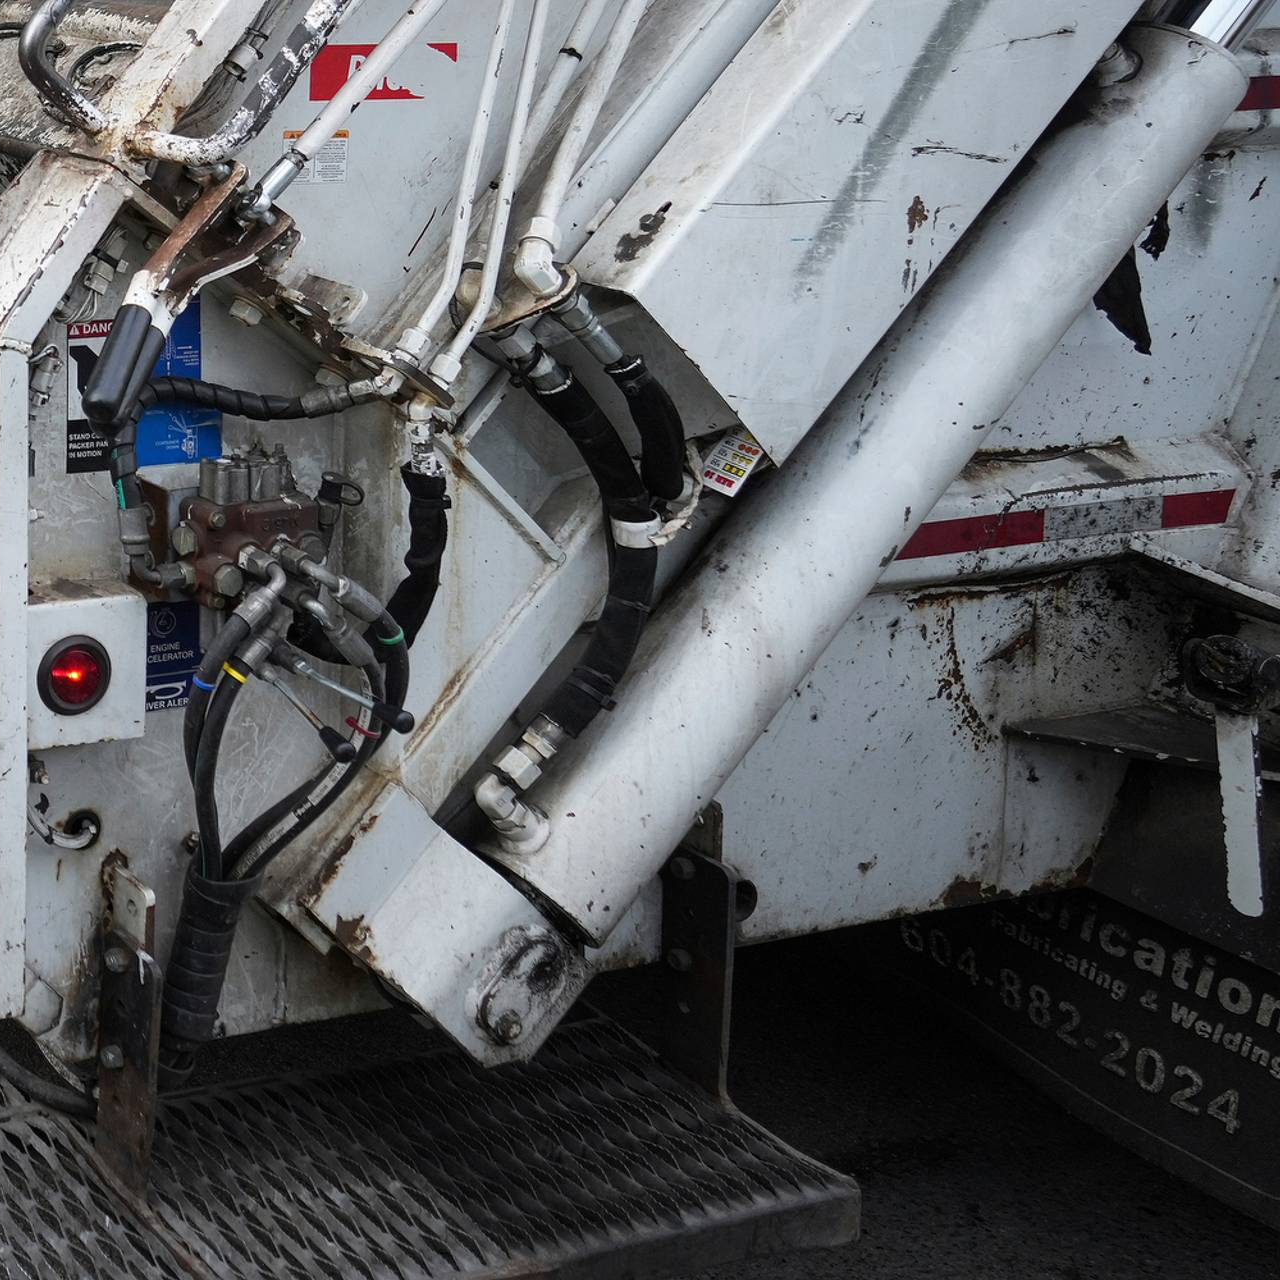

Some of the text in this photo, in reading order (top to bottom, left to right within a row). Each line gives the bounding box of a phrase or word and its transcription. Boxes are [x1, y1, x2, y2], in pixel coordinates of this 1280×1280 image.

[82, 322, 112, 335] DAN
[68, 433, 91, 441] STAND
[68, 441, 95, 450] PACKER
[77, 449, 102, 458] MOTION
[150, 641, 181, 653] ENGINE
[147, 650, 194, 664] CELERATOR
[145, 697, 190, 711] IVER ALER
[1139, 988, 1160, 1013] &
[899, 918, 1241, 1136] 604-882-2024
